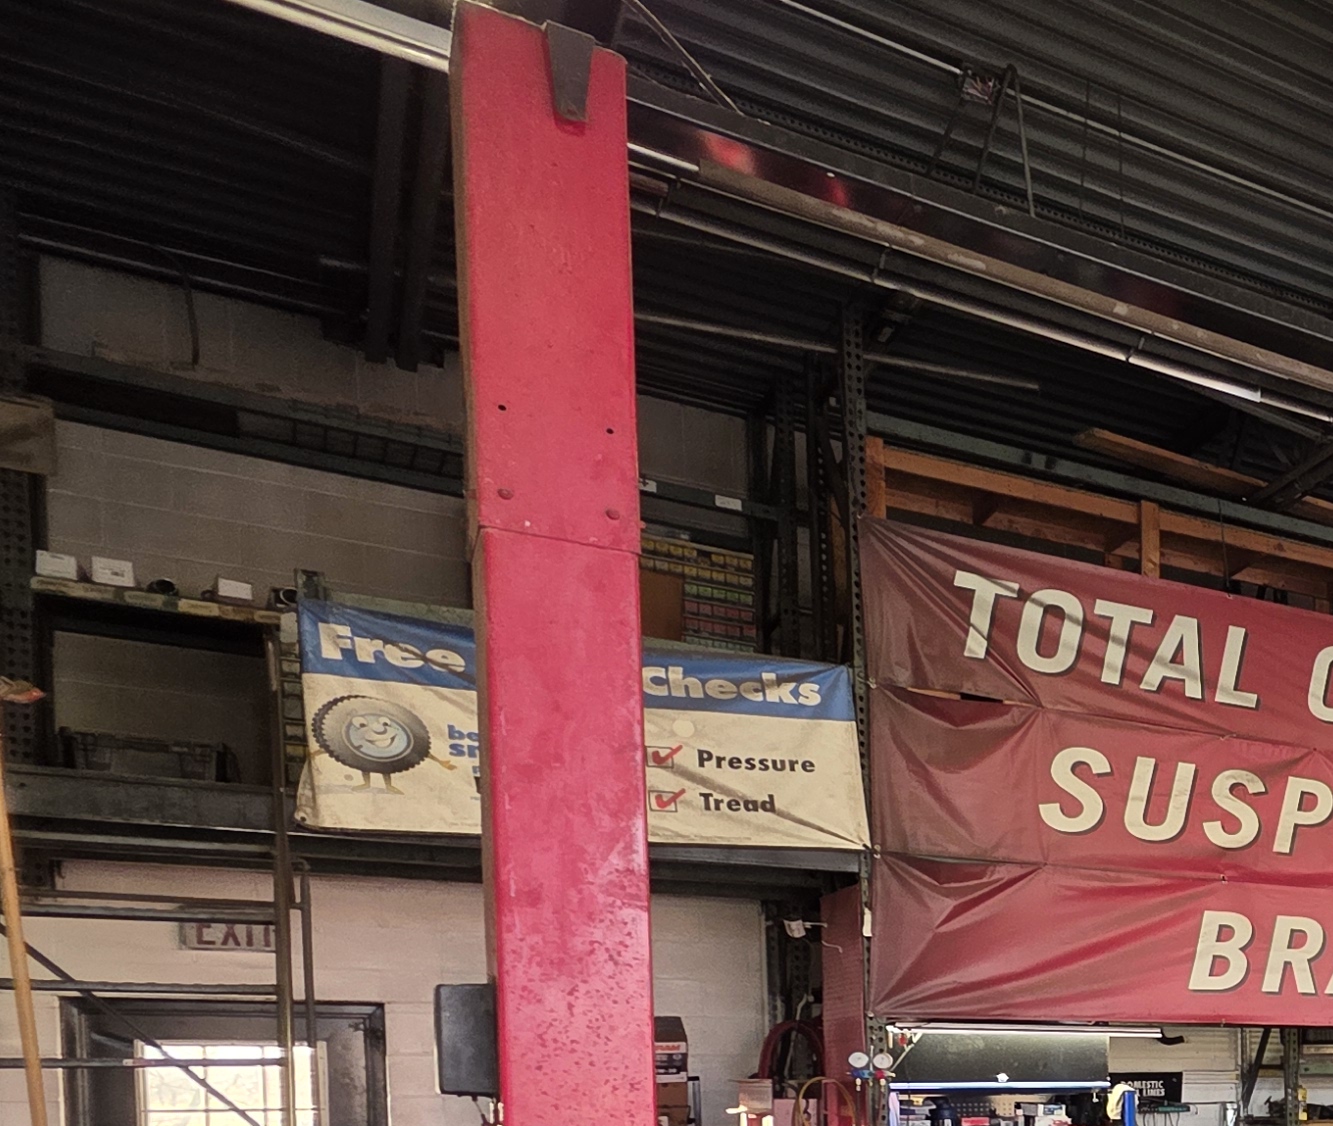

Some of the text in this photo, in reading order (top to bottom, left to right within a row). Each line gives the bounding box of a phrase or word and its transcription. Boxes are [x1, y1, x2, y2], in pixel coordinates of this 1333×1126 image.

[318, 621, 822, 707] Free Checks
[953, 570, 1259, 709] TOTAL
[697, 748, 816, 773] Pressure
[699, 792, 777, 813] Tread
